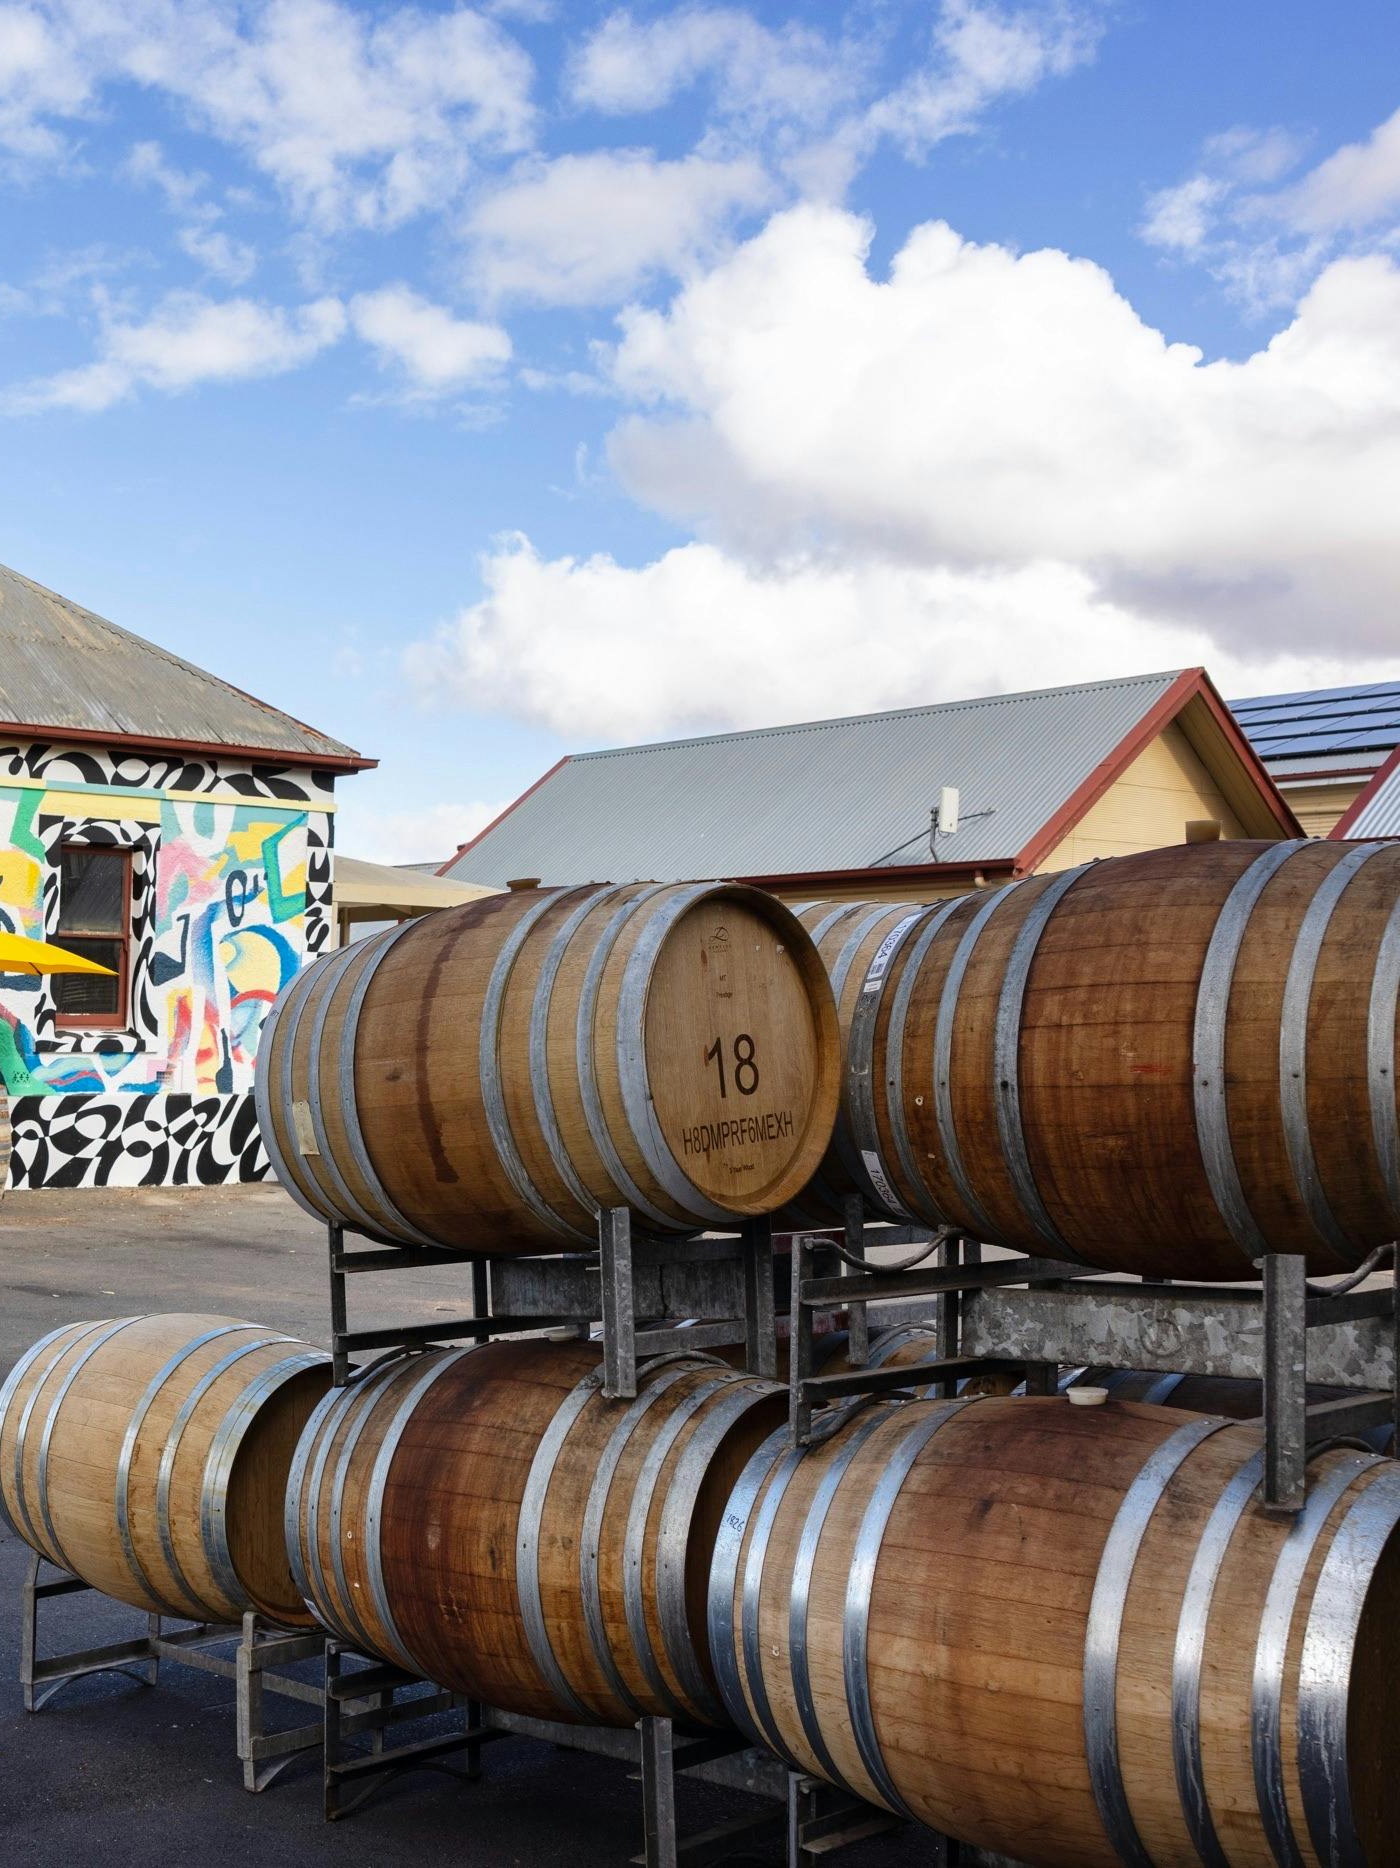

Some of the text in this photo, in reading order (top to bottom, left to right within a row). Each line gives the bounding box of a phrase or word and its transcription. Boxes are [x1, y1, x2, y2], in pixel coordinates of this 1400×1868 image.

[707, 1033, 760, 1099] 18
[682, 1110, 795, 1155] H8DMPRF6MEXH
[726, 1513, 745, 1532] 1826
